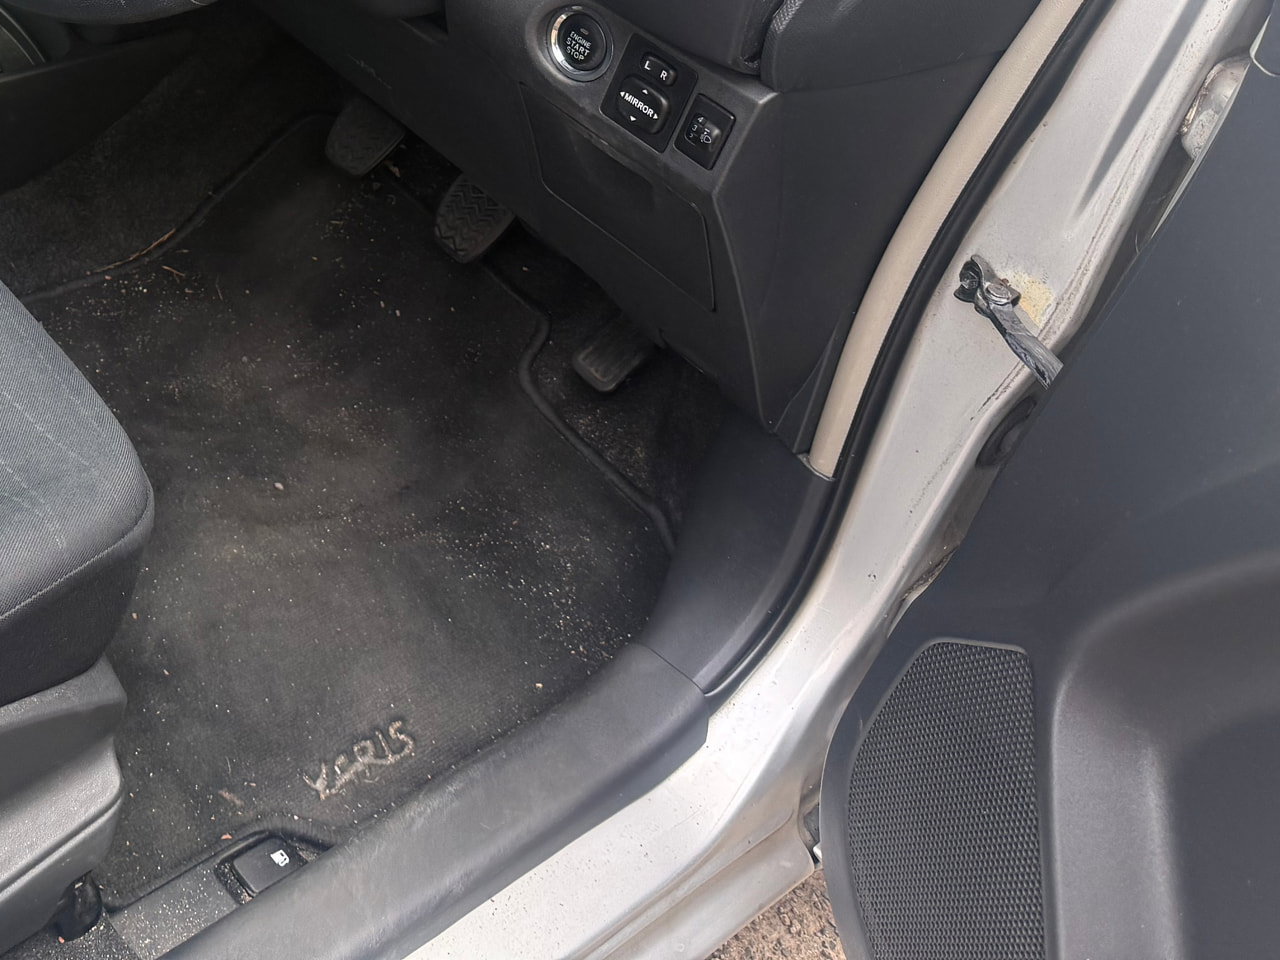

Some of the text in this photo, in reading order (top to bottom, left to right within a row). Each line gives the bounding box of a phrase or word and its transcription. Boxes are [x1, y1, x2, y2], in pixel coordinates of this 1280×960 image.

[565, 37, 591, 57] START
[569, 31, 592, 49] ENGINE
[565, 45, 585, 61] STOP
[644, 60, 651, 71] L
[660, 69, 668, 81] R
[623, 92, 655, 118] MIRROR
[300, 720, 418, 802] YARIS
